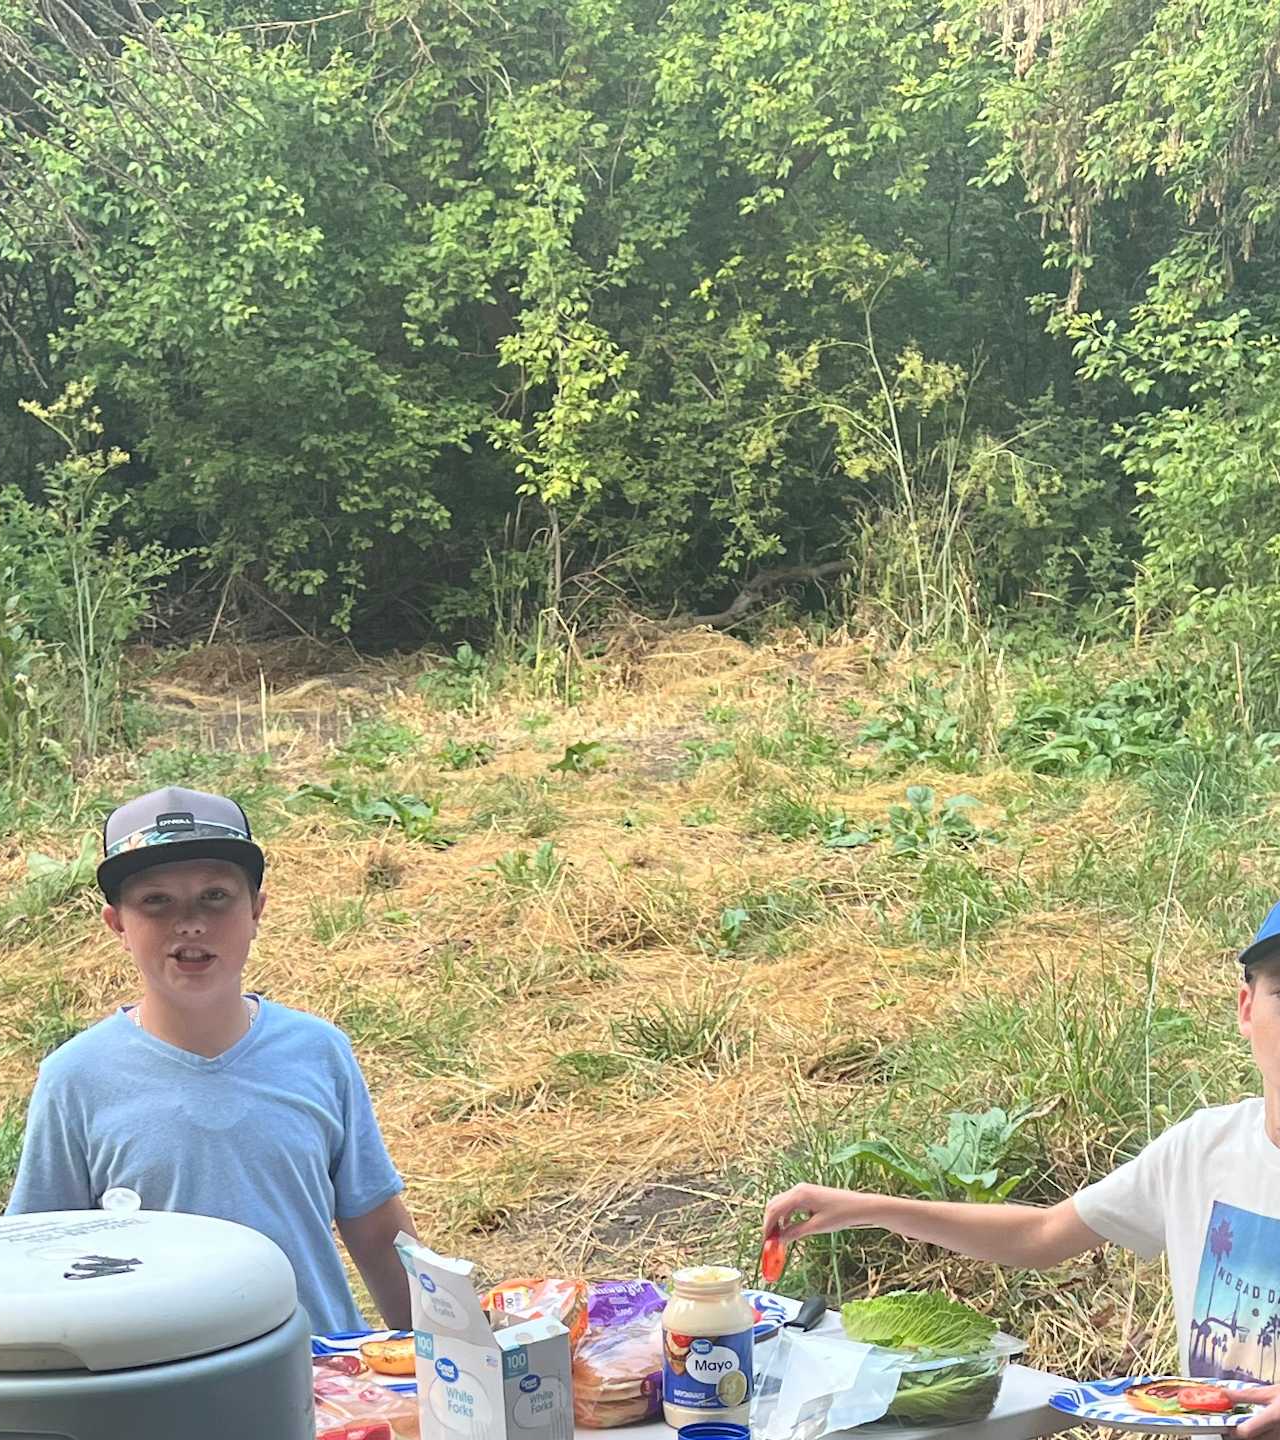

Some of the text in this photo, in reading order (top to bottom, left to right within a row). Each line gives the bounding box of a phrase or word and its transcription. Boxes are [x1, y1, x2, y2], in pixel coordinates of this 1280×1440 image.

[1218, 1266, 1233, 1286] NO
[1235, 1278, 1261, 1299] BAD
[417, 1335, 433, 1353] 100
[506, 1352, 527, 1369] 100
[695, 1360, 733, 1373] Mayo
[446, 1386, 474, 1405] White
[447, 1400, 474, 1418] Forks
